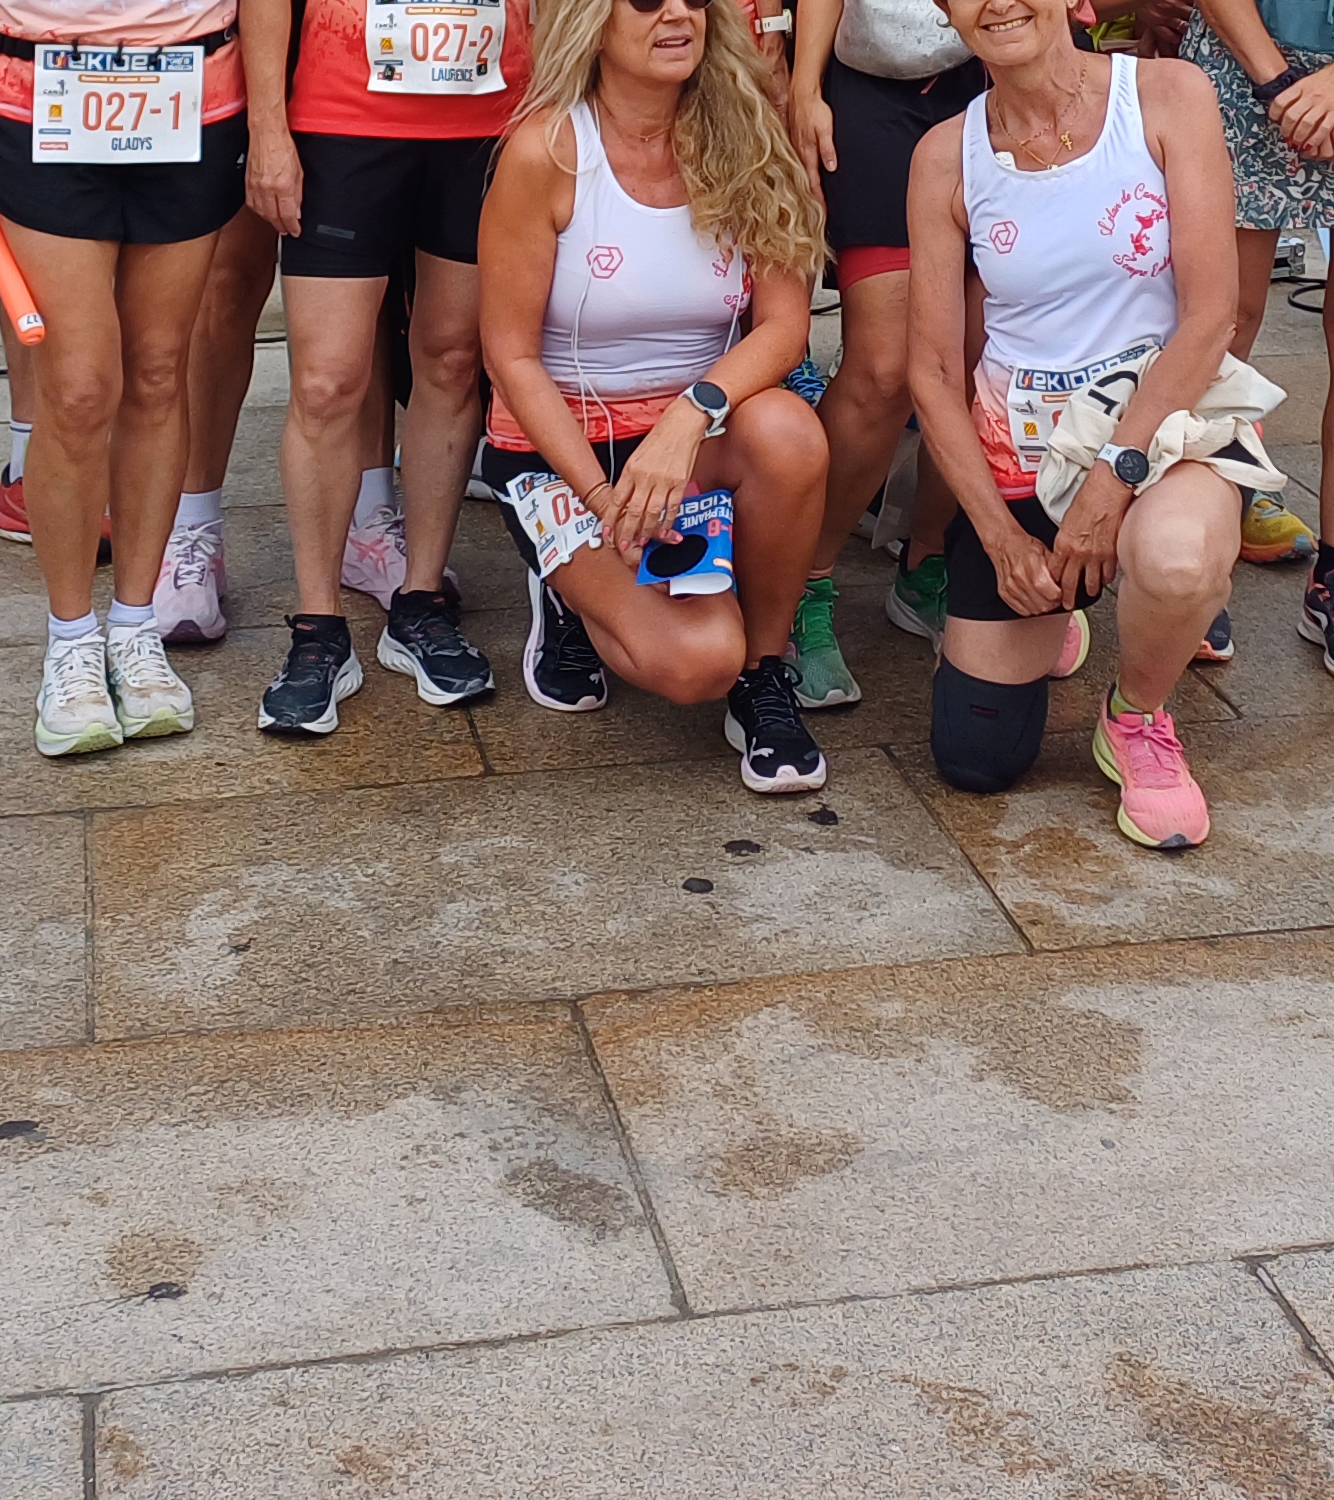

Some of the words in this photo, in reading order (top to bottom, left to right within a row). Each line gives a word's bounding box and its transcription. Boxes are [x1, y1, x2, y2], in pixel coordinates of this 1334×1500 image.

[410, 22, 494, 65] 027-2
[431, 67, 474, 83] LAURENCE
[82, 90, 182, 132] 027-1
[110, 136, 154, 151] GLADYS
